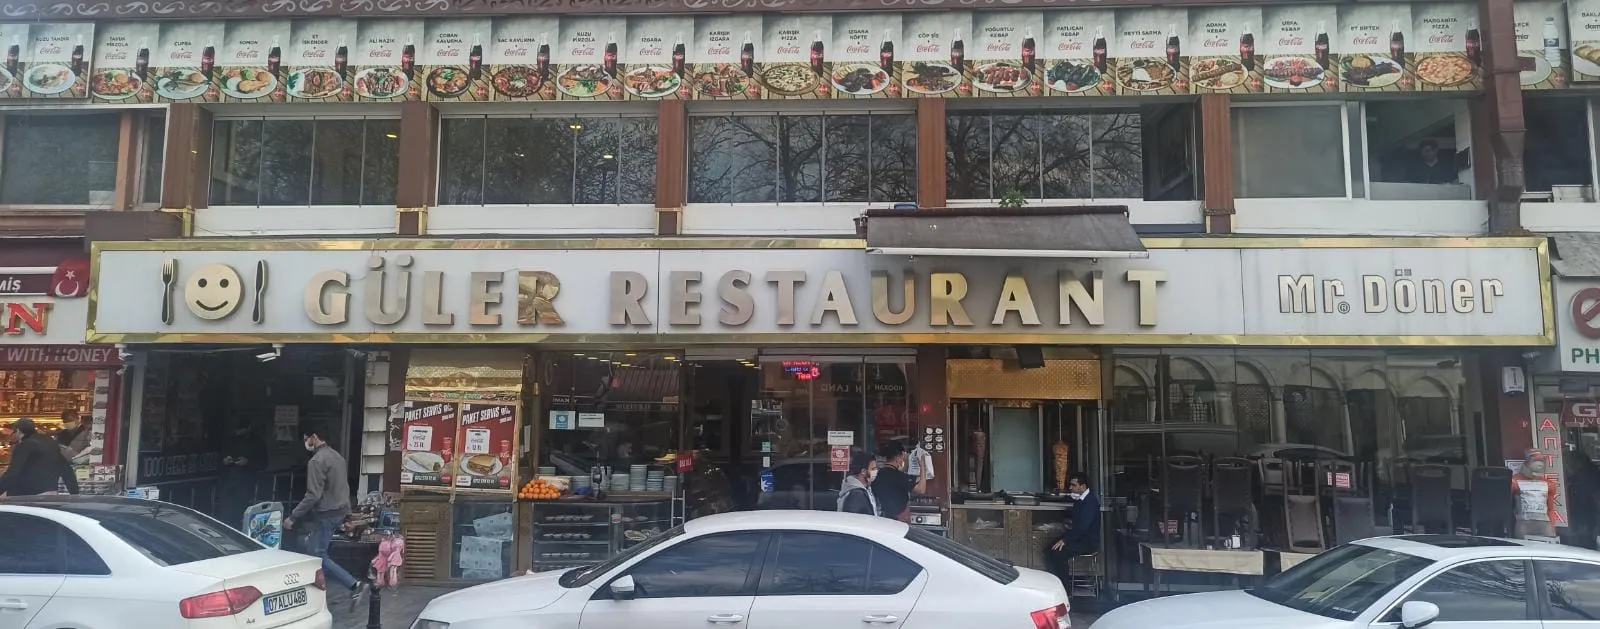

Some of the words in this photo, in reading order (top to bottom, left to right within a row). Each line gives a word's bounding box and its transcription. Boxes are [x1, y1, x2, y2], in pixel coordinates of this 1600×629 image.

[303, 254, 566, 326] GÜLER
[608, 269, 1169, 327] RESTAURANT
[1362, 268, 1504, 314] Döner
[0, 302, 52, 336] N
[1572, 348, 1600, 364] PH
[404, 409, 422, 422] PAKET
[1572, 402, 1600, 417] G
[462, 411, 480, 425] PAKET
